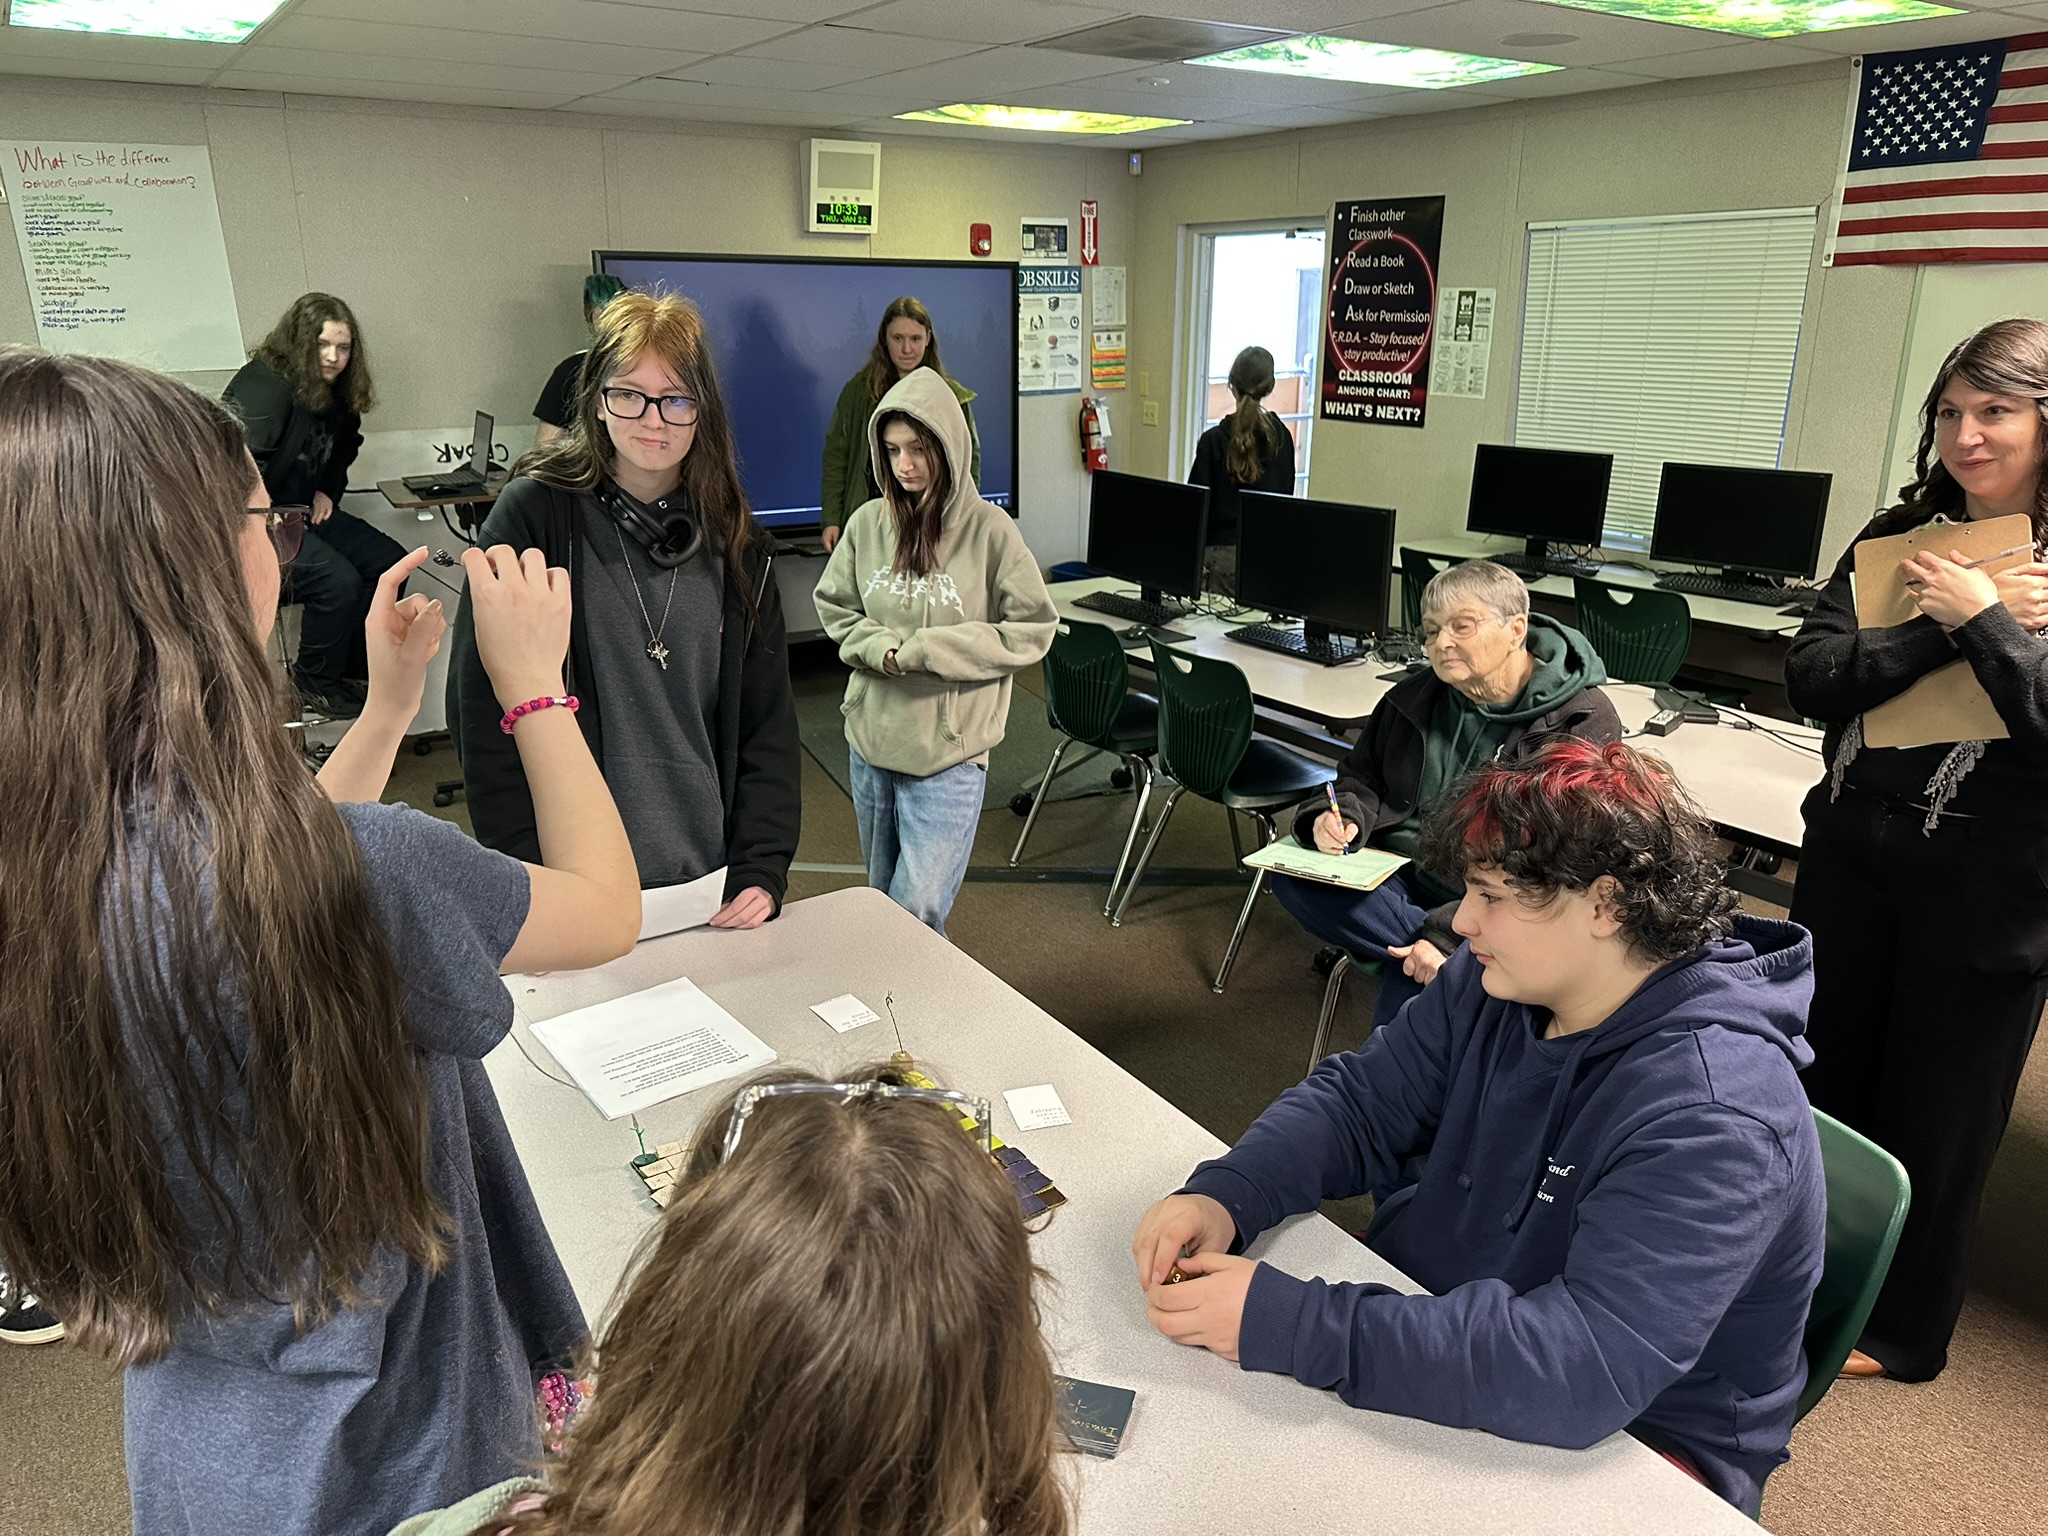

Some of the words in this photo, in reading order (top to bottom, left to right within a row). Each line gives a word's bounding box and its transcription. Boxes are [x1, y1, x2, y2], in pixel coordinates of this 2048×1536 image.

[14, 146, 66, 174] What
[96, 150, 116, 167] the
[829, 204, 859, 215] 10:33
[1083, 206, 1095, 216] FIRE
[1350, 206, 1378, 223] Finish
[1380, 209, 1405, 222] other
[857, 216, 867, 224] 22
[1348, 226, 1393, 241] Classwork
[1346, 251, 1372, 268] Read
[1373, 258, 1379, 268] a
[1381, 254, 1405, 268] Book
[1018, 270, 1035, 287] OB
[1036, 270, 1080, 287] SKILLS
[1344, 277, 1371, 295] Draw
[1372, 284, 1382, 295] or
[1383, 281, 1415, 295] Sketch
[1345, 304, 1364, 322] Ask
[1365, 309, 1379, 322] for
[1379, 310, 1431, 323] Permission
[1369, 331, 1389, 347] Stay
[1343, 348, 1361, 362] stay
[1361, 349, 1411, 363] productive!
[1338, 369, 1413, 385] CLASSROOM
[1337, 385, 1375, 398] ANCHOR
[1376, 388, 1411, 400] CHART:
[1324, 400, 1373, 418] WHAT'S
[1376, 405, 1421, 421] NEXT?
